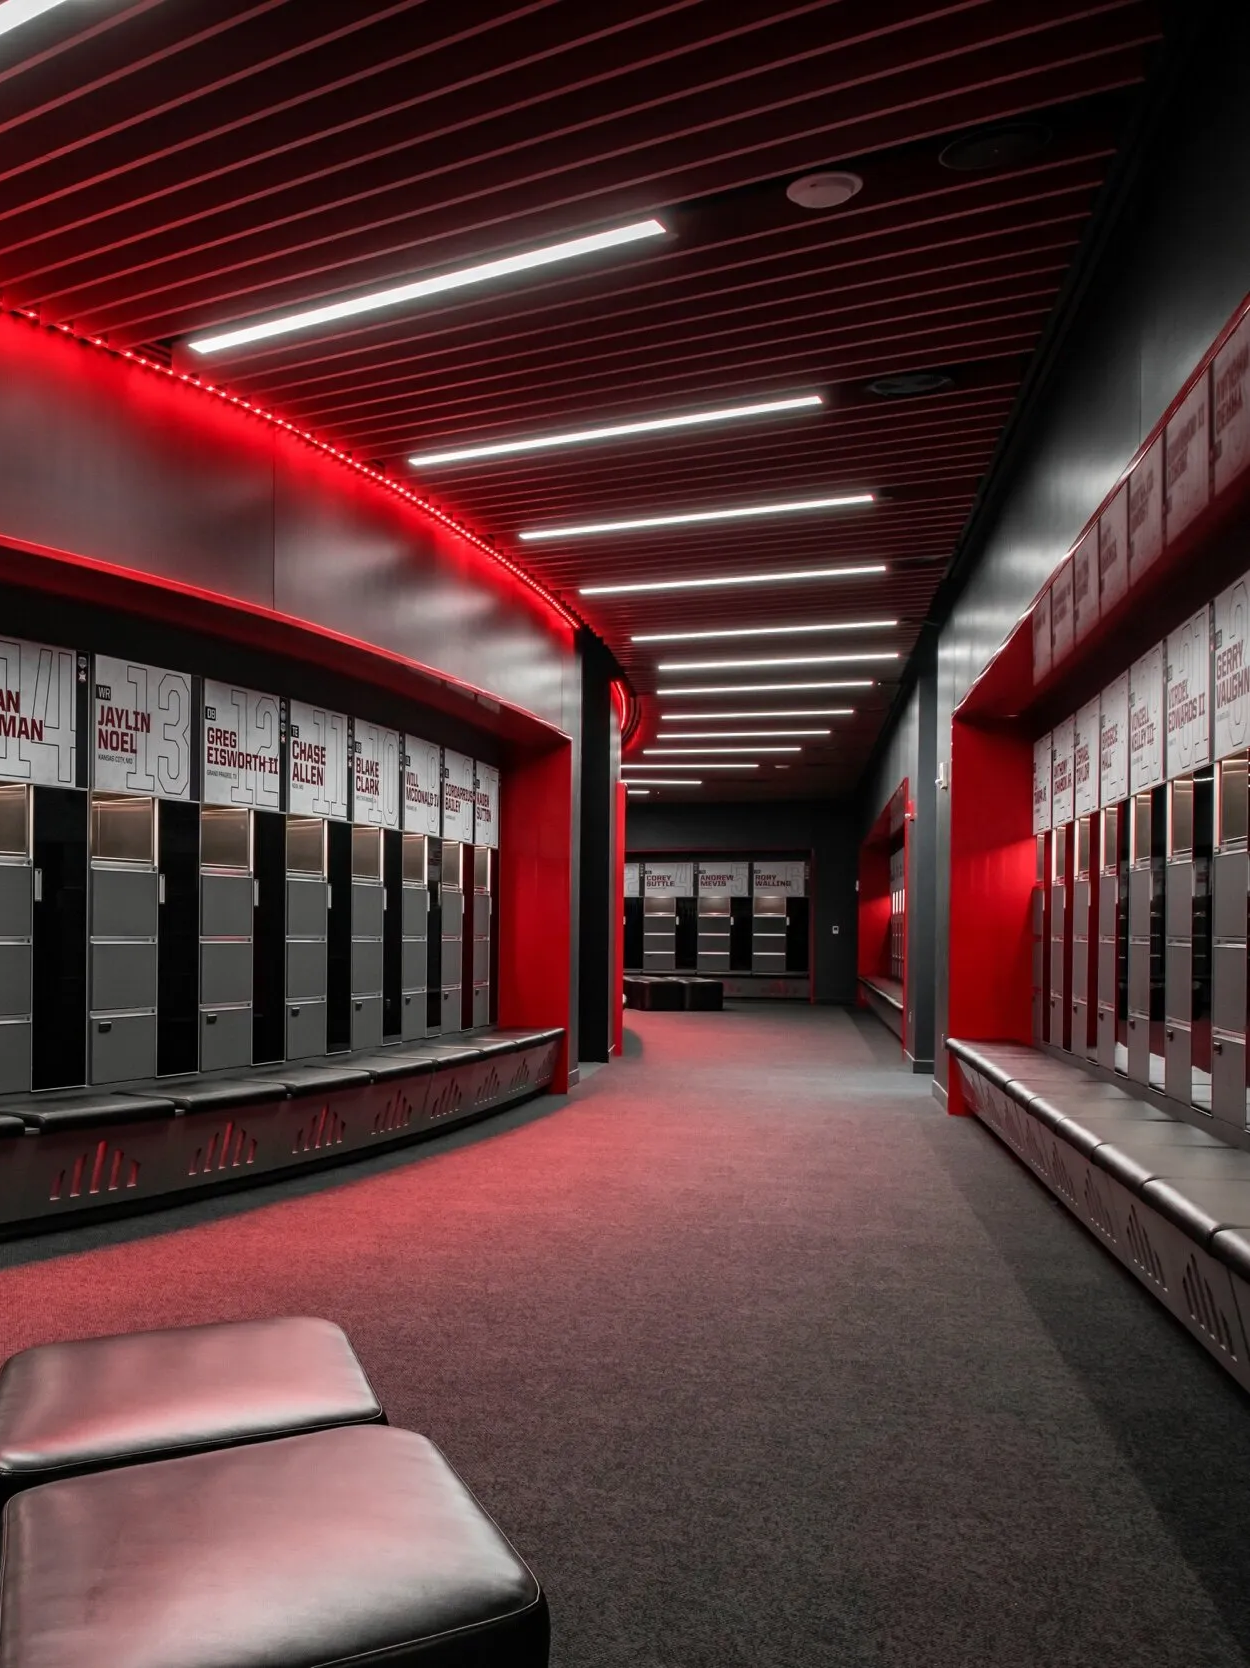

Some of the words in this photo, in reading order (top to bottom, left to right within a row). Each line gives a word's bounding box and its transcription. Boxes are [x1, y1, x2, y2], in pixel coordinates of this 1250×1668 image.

[1216, 639, 1243, 680] GERRY
[98, 686, 111, 700] WR
[1216, 667, 1250, 710] VAUGHN
[97, 704, 151, 733] JAYLIN
[126, 665, 190, 795] 13
[98, 727, 138, 754] NOEL
[207, 726, 237, 749] GREG
[231, 689, 279, 808] 12
[207, 746, 266, 773] EISWORTH
[268, 757, 279, 775] II
[292, 740, 326, 767] CHASE
[292, 762, 324, 787] ALLEN
[355, 757, 379, 778] BLAKE
[355, 775, 380, 796] CLARK
